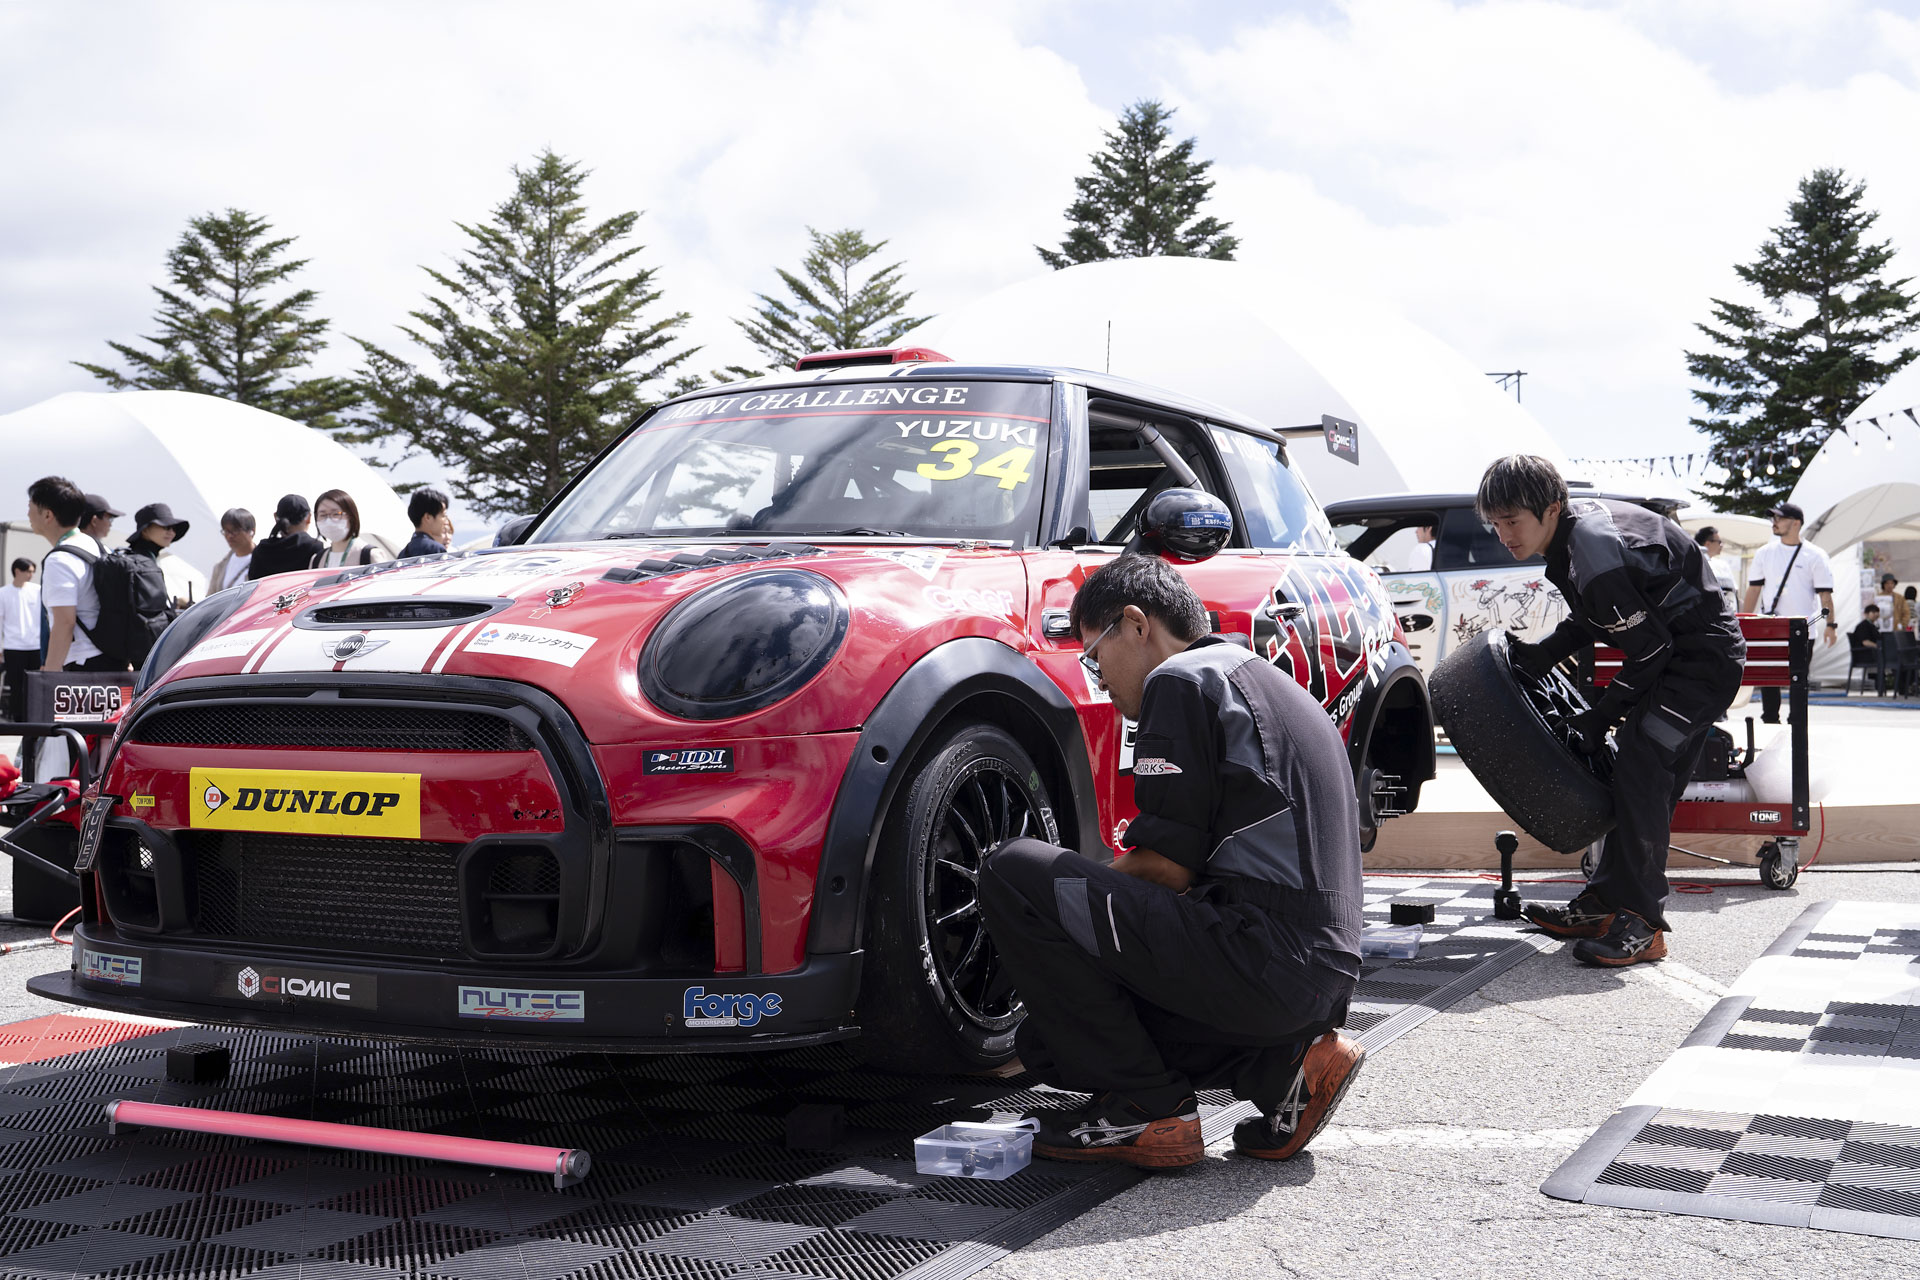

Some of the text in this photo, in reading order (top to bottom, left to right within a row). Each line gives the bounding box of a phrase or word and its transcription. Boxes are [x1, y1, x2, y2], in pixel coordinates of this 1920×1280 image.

[664, 387, 969, 421] MINI CHALLENGE
[895, 420, 1037, 446] YUZUKI
[916, 439, 1036, 491] 34
[337, 641, 362, 650] MINI
[54, 685, 121, 714] SYCG
[232, 788, 400, 816] DUNLOP
[1752, 813, 1779, 822] TONE
